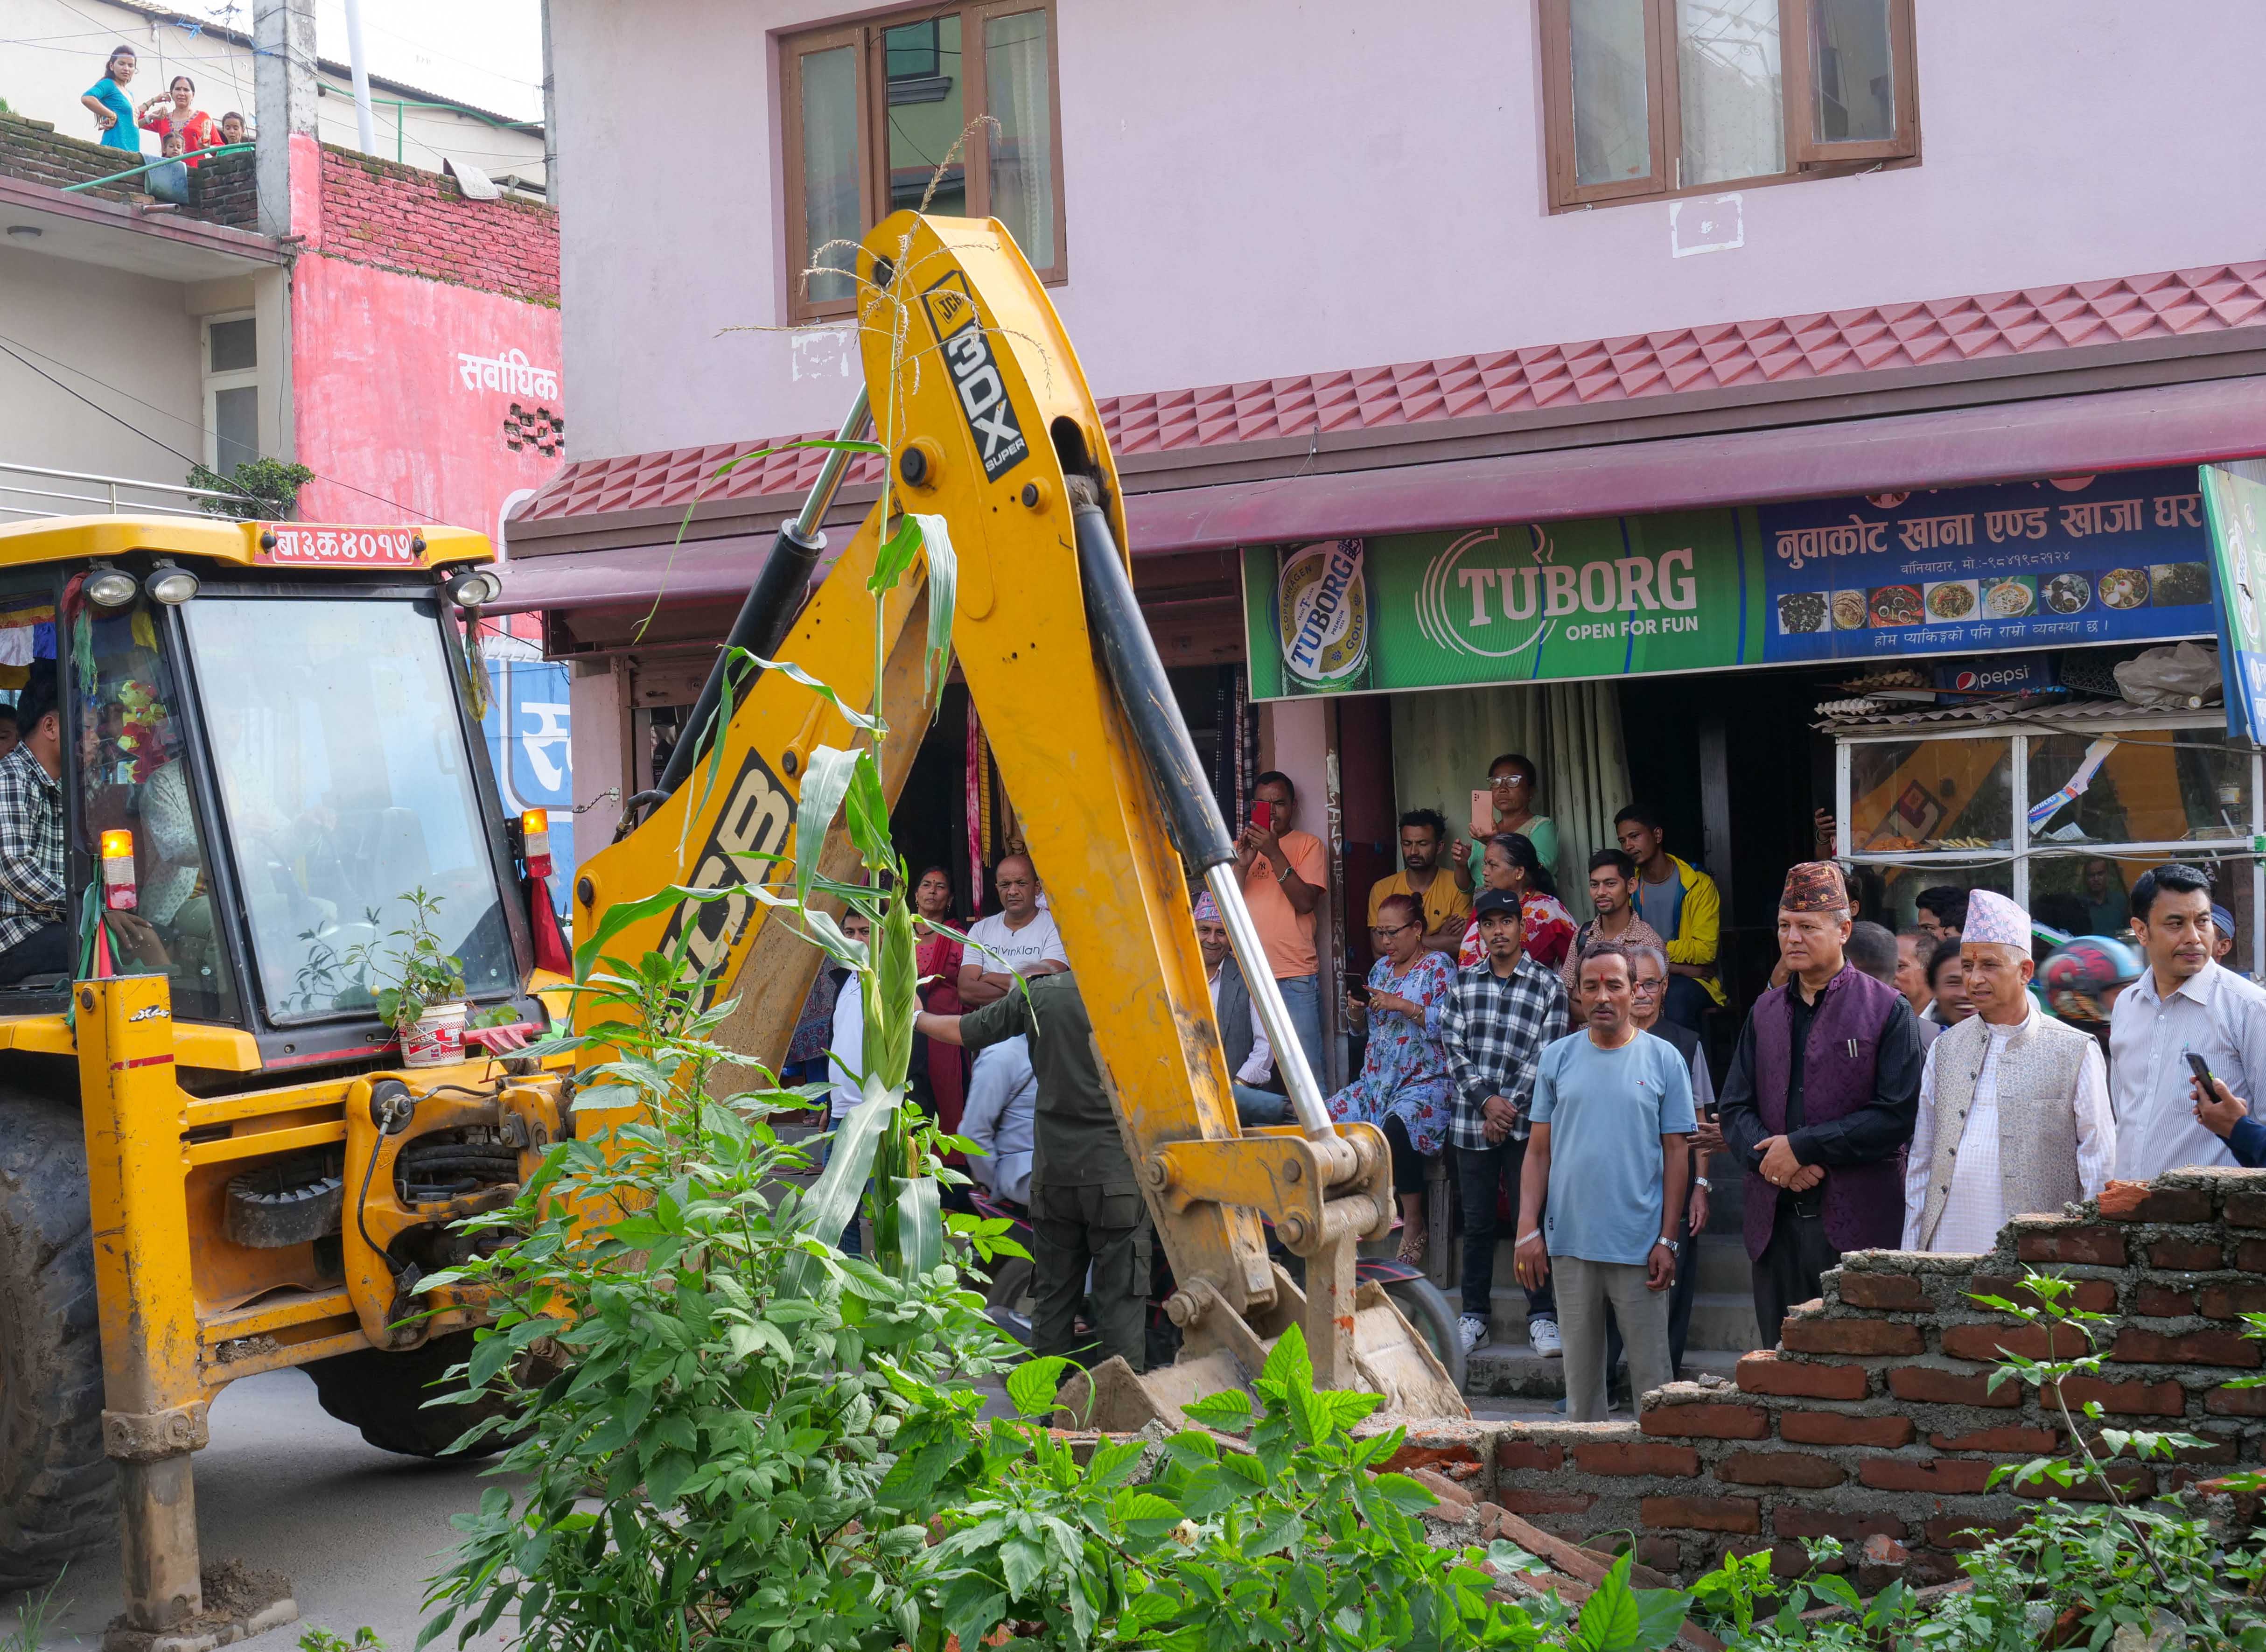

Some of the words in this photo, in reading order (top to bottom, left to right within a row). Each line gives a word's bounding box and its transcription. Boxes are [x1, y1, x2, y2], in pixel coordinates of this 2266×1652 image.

[939, 295, 967, 321] JCB
[458, 348, 558, 401] सर्वाधिक
[948, 325, 1021, 461] 3DX
[985, 437, 1026, 472] SUPER
[1775, 514, 1889, 569] नुवाकोट
[1897, 513, 1975, 552] खाना
[1984, 507, 2049, 543] एण्ड
[2059, 498, 2143, 538] खाजा
[2154, 493, 2203, 528] घर
[1283, 565, 1312, 631] COPENHAGEN
[1459, 547, 1697, 627] TUBORG
[1290, 554, 1357, 669] TUBORG
[1331, 609, 1345, 635] PREMIUM
[1565, 623, 1615, 641] OPEN
[1620, 619, 1657, 637] FOR
[1662, 616, 1699, 634] FUN
[1346, 615, 1363, 650] GOLD
[1874, 632, 1898, 647] होम
[1970, 624, 1993, 640] पनि
[1999, 621, 2026, 638] राम्रो
[2086, 620, 2098, 633] छ
[1980, 665, 2029, 687] pepsi
